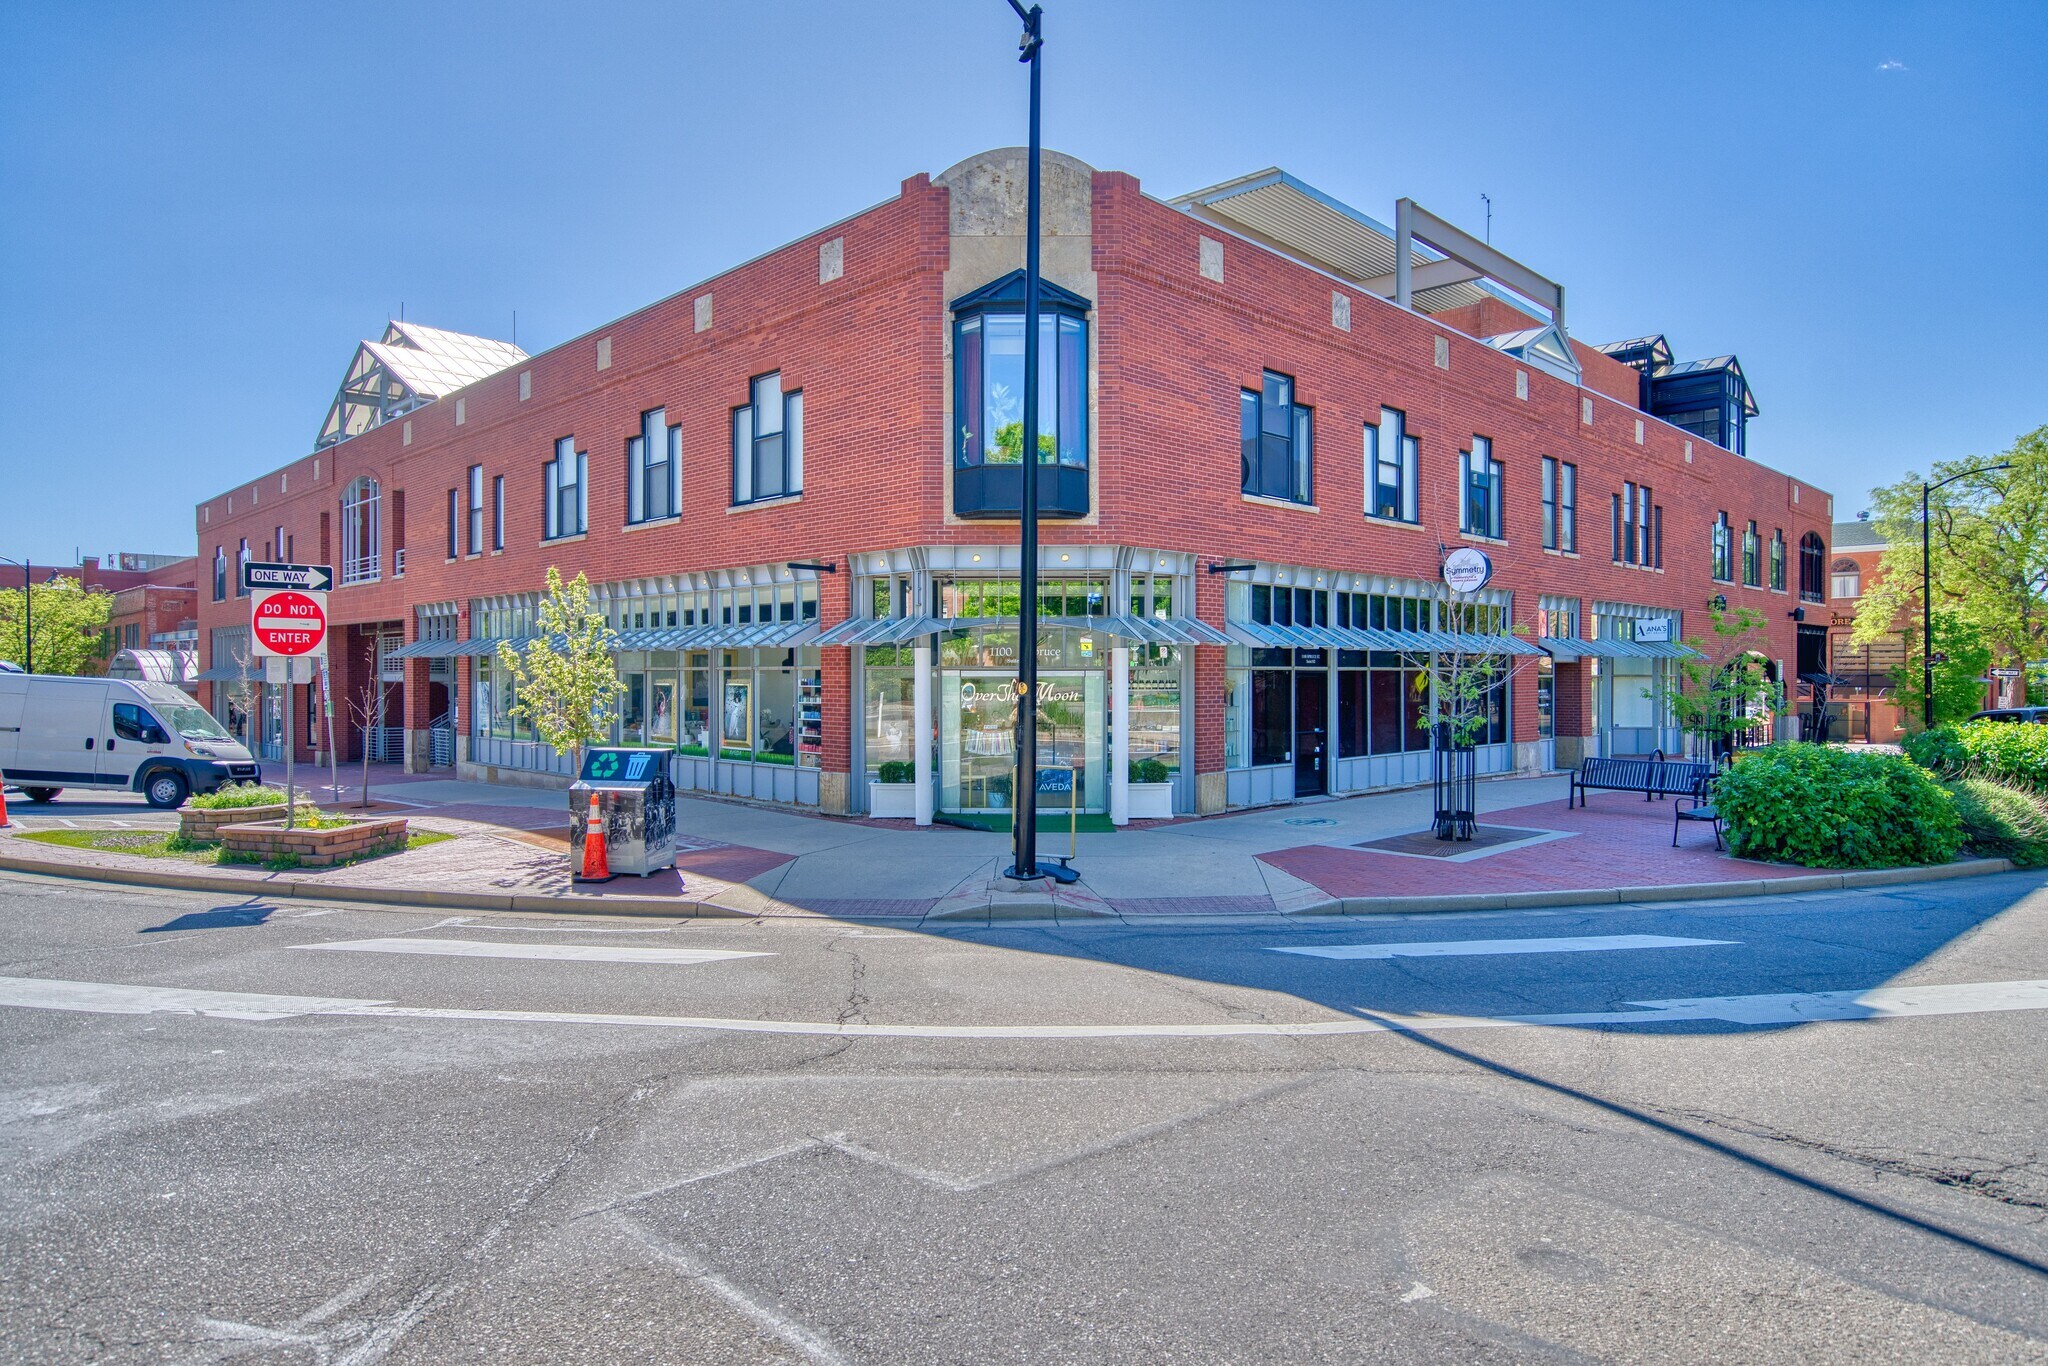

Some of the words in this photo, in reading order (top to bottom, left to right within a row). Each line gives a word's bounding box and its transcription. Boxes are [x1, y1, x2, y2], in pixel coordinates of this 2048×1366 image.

[254, 570, 279, 582] ONE
[282, 571, 307, 583] WAY
[1446, 566, 1484, 576] Symmetry
[264, 604, 282, 615] DO
[289, 604, 316, 616] NOT
[269, 632, 311, 644] ENTER
[989, 647, 1013, 657] 1100
[1036, 682, 1079, 701] Moon
[1038, 783, 1072, 791] AVEDA
